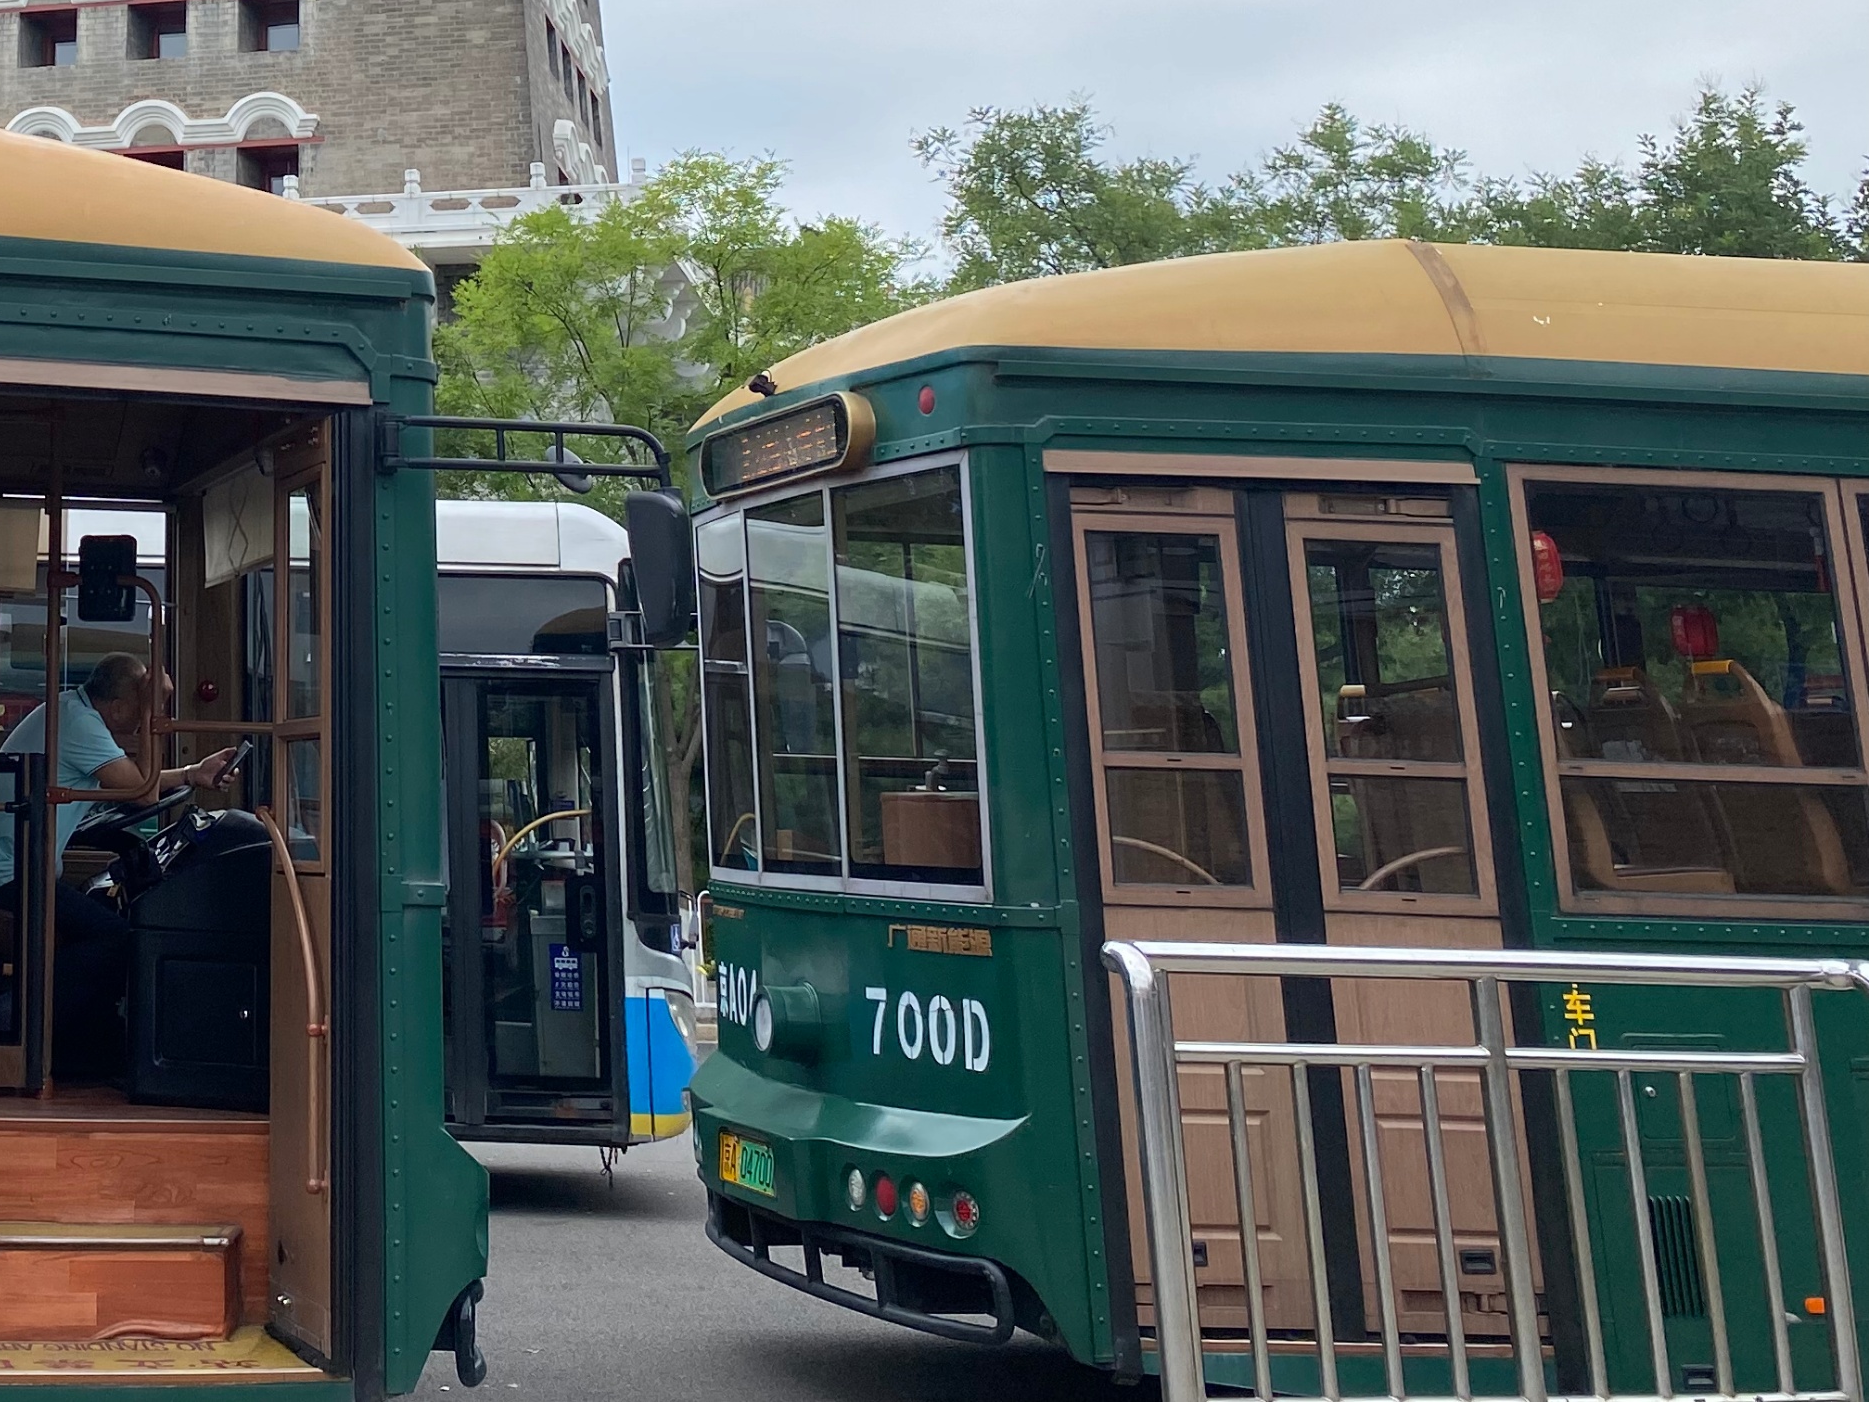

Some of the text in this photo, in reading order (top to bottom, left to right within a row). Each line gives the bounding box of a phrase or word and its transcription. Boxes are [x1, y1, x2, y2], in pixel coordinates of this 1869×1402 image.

[888, 923, 993, 957] 广通新能源
[865, 986, 991, 1072] 700D
